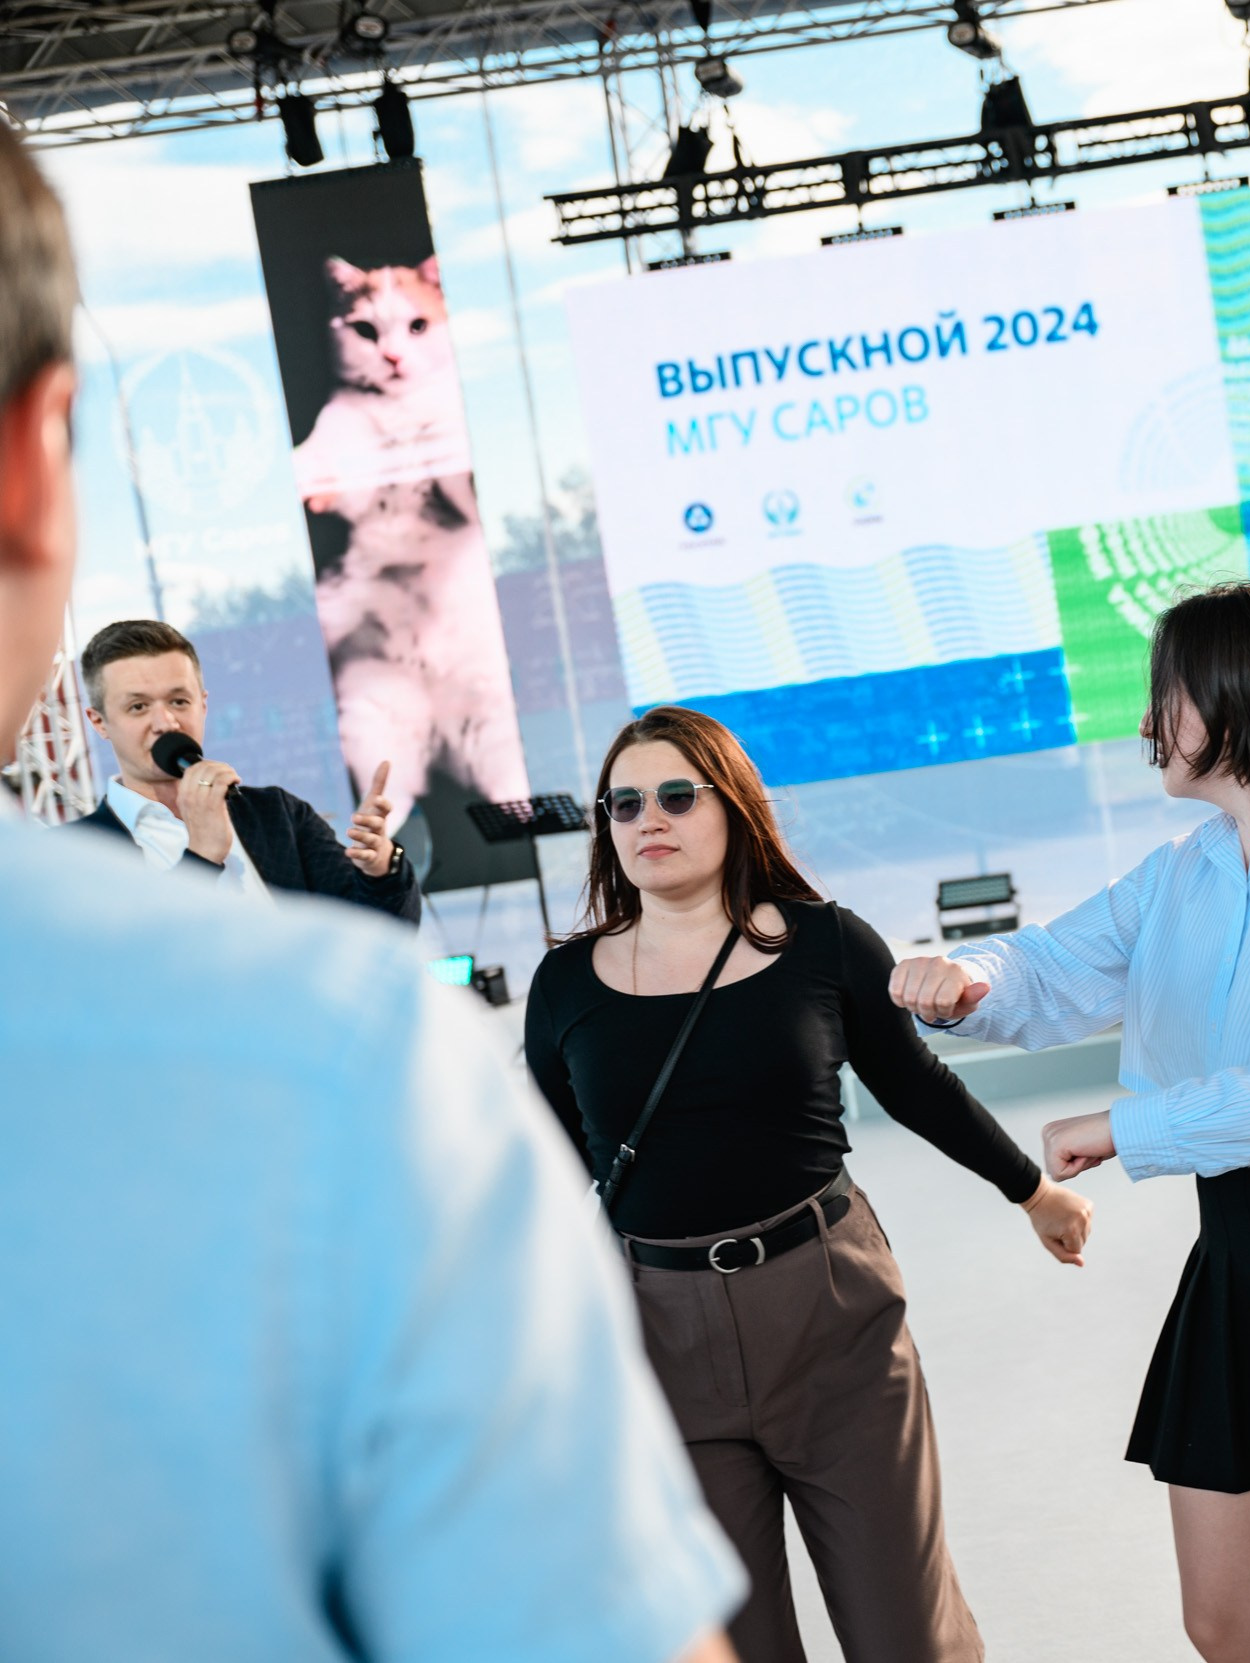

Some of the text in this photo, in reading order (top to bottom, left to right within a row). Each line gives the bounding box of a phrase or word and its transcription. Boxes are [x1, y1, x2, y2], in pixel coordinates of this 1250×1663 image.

[656, 302, 1100, 399] ВЫПУСКНОЙ 2024
[667, 384, 931, 458] МГУ САРОВ
